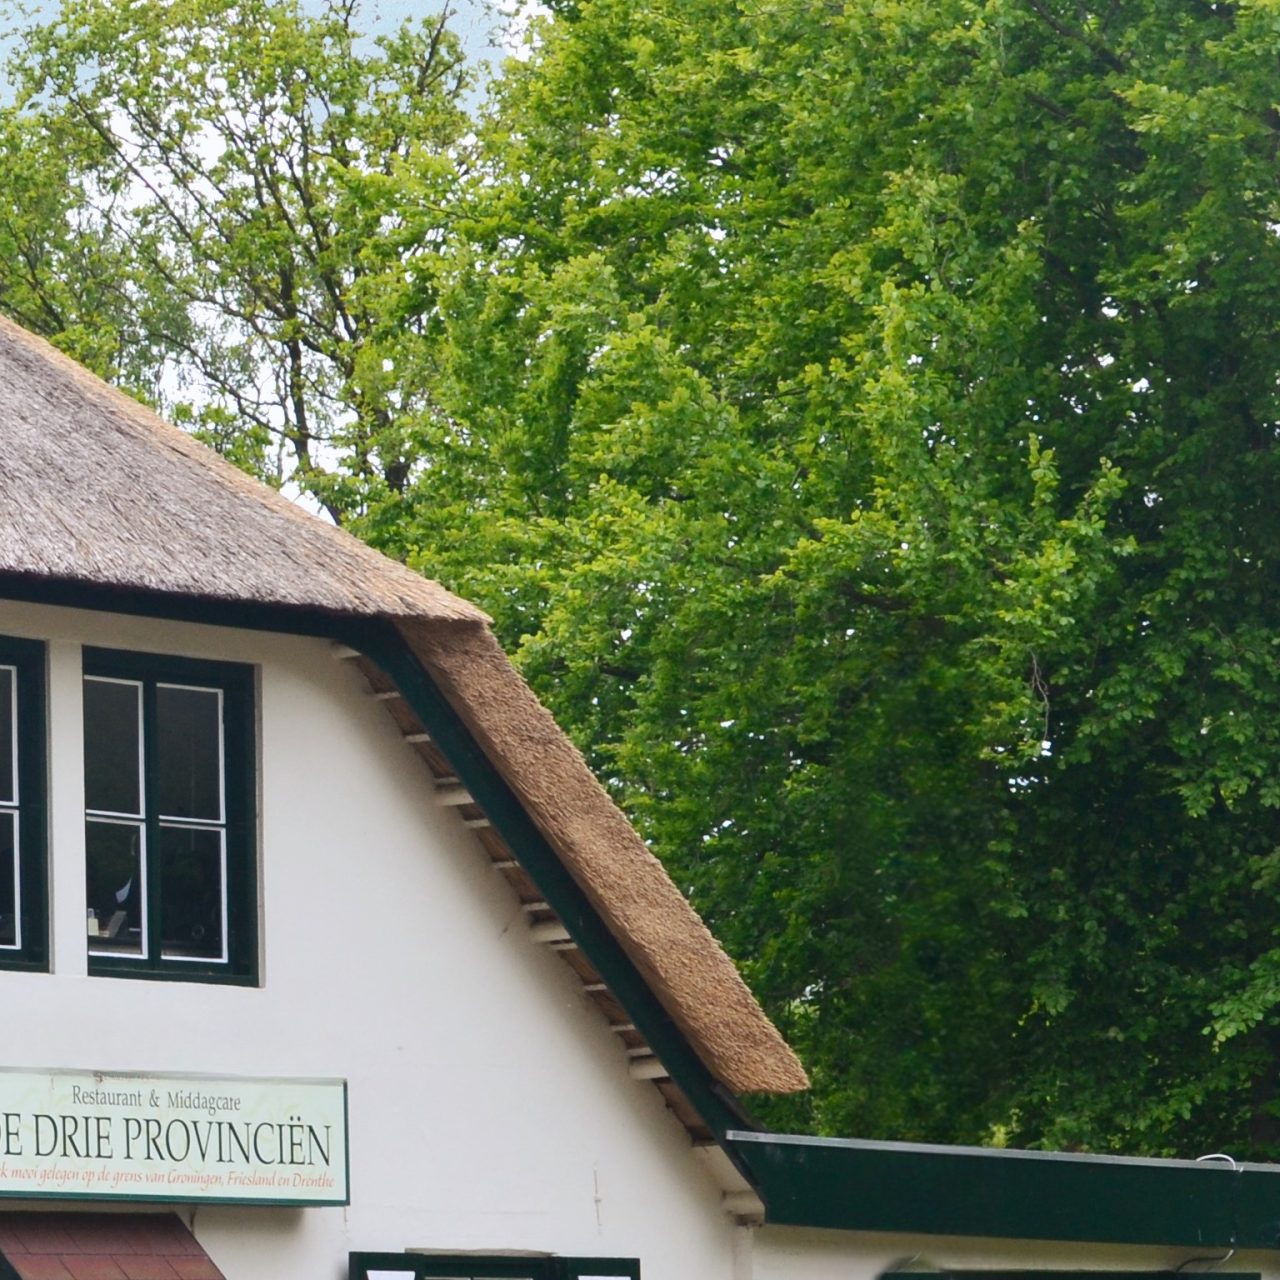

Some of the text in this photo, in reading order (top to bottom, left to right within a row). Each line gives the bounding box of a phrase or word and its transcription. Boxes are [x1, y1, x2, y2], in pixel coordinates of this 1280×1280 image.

[72, 1085, 241, 1116] Restaurant & Middagcare
[32, 1114, 114, 1159] DRIE
[122, 1115, 333, 1166] PROVINCIËN
[11, 1166, 38, 1180] mooi
[39, 1164, 80, 1187] gelegen
[81, 1170, 96, 1187] op
[97, 1164, 111, 1182] de
[112, 1172, 143, 1188] grens
[145, 1172, 165, 1184] van
[167, 1169, 224, 1191] Groningen,
[227, 1170, 276, 1188] Friesland
[277, 1175, 290, 1187] en
[292, 1172, 336, 1188] Drenthe
